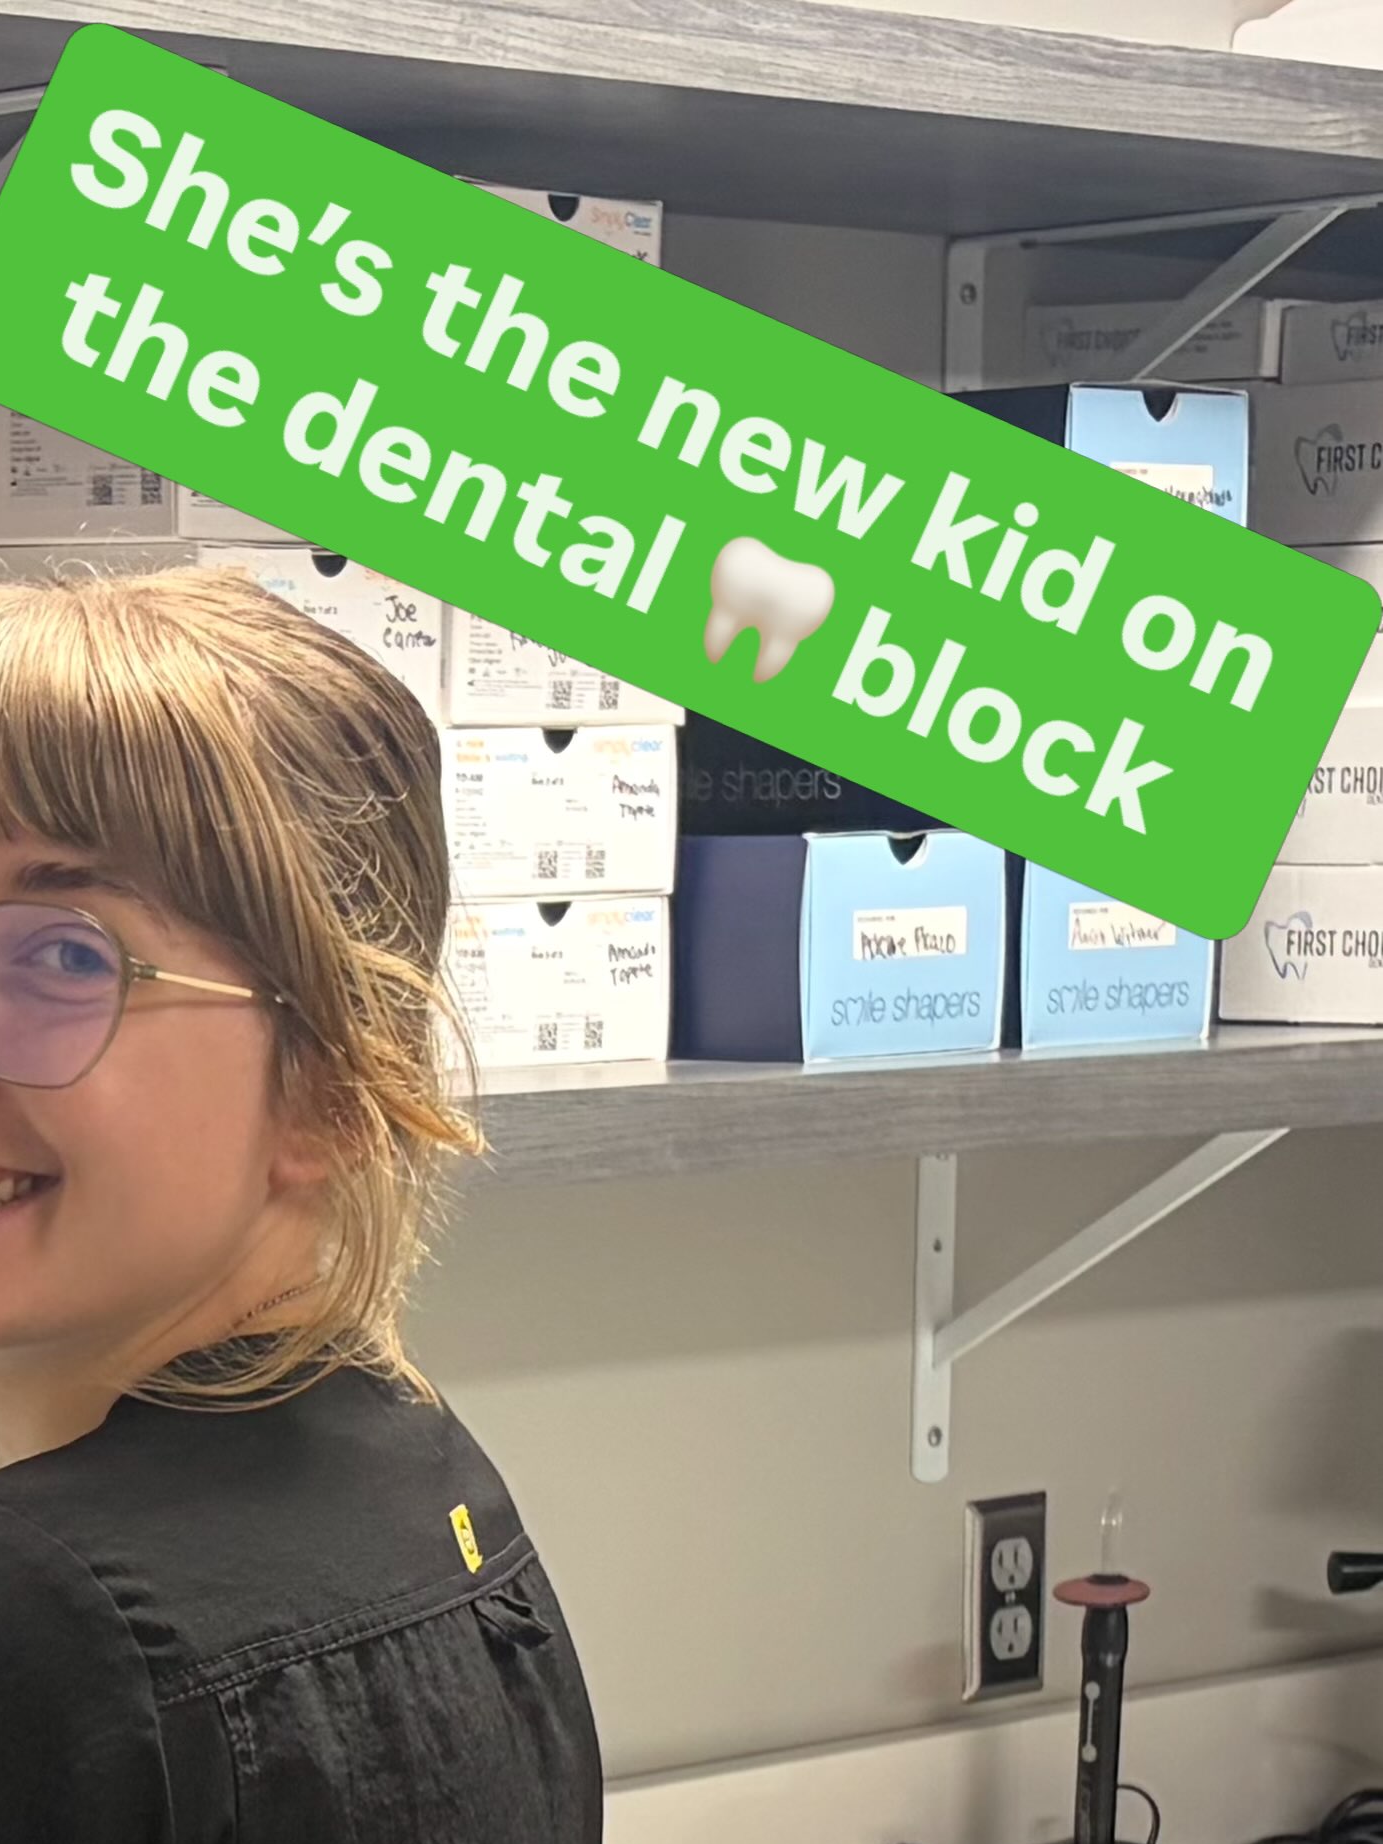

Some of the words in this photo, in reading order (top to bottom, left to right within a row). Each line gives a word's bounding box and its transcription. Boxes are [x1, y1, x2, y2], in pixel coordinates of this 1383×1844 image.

[1317, 445, 1365, 473] FIRST
[385, 596, 417, 623] Joe
[722, 760, 841, 807] shapers
[1286, 930, 1337, 957] FIRST
[892, 986, 980, 1027] shapers
[1106, 976, 1190, 1015] shapers
